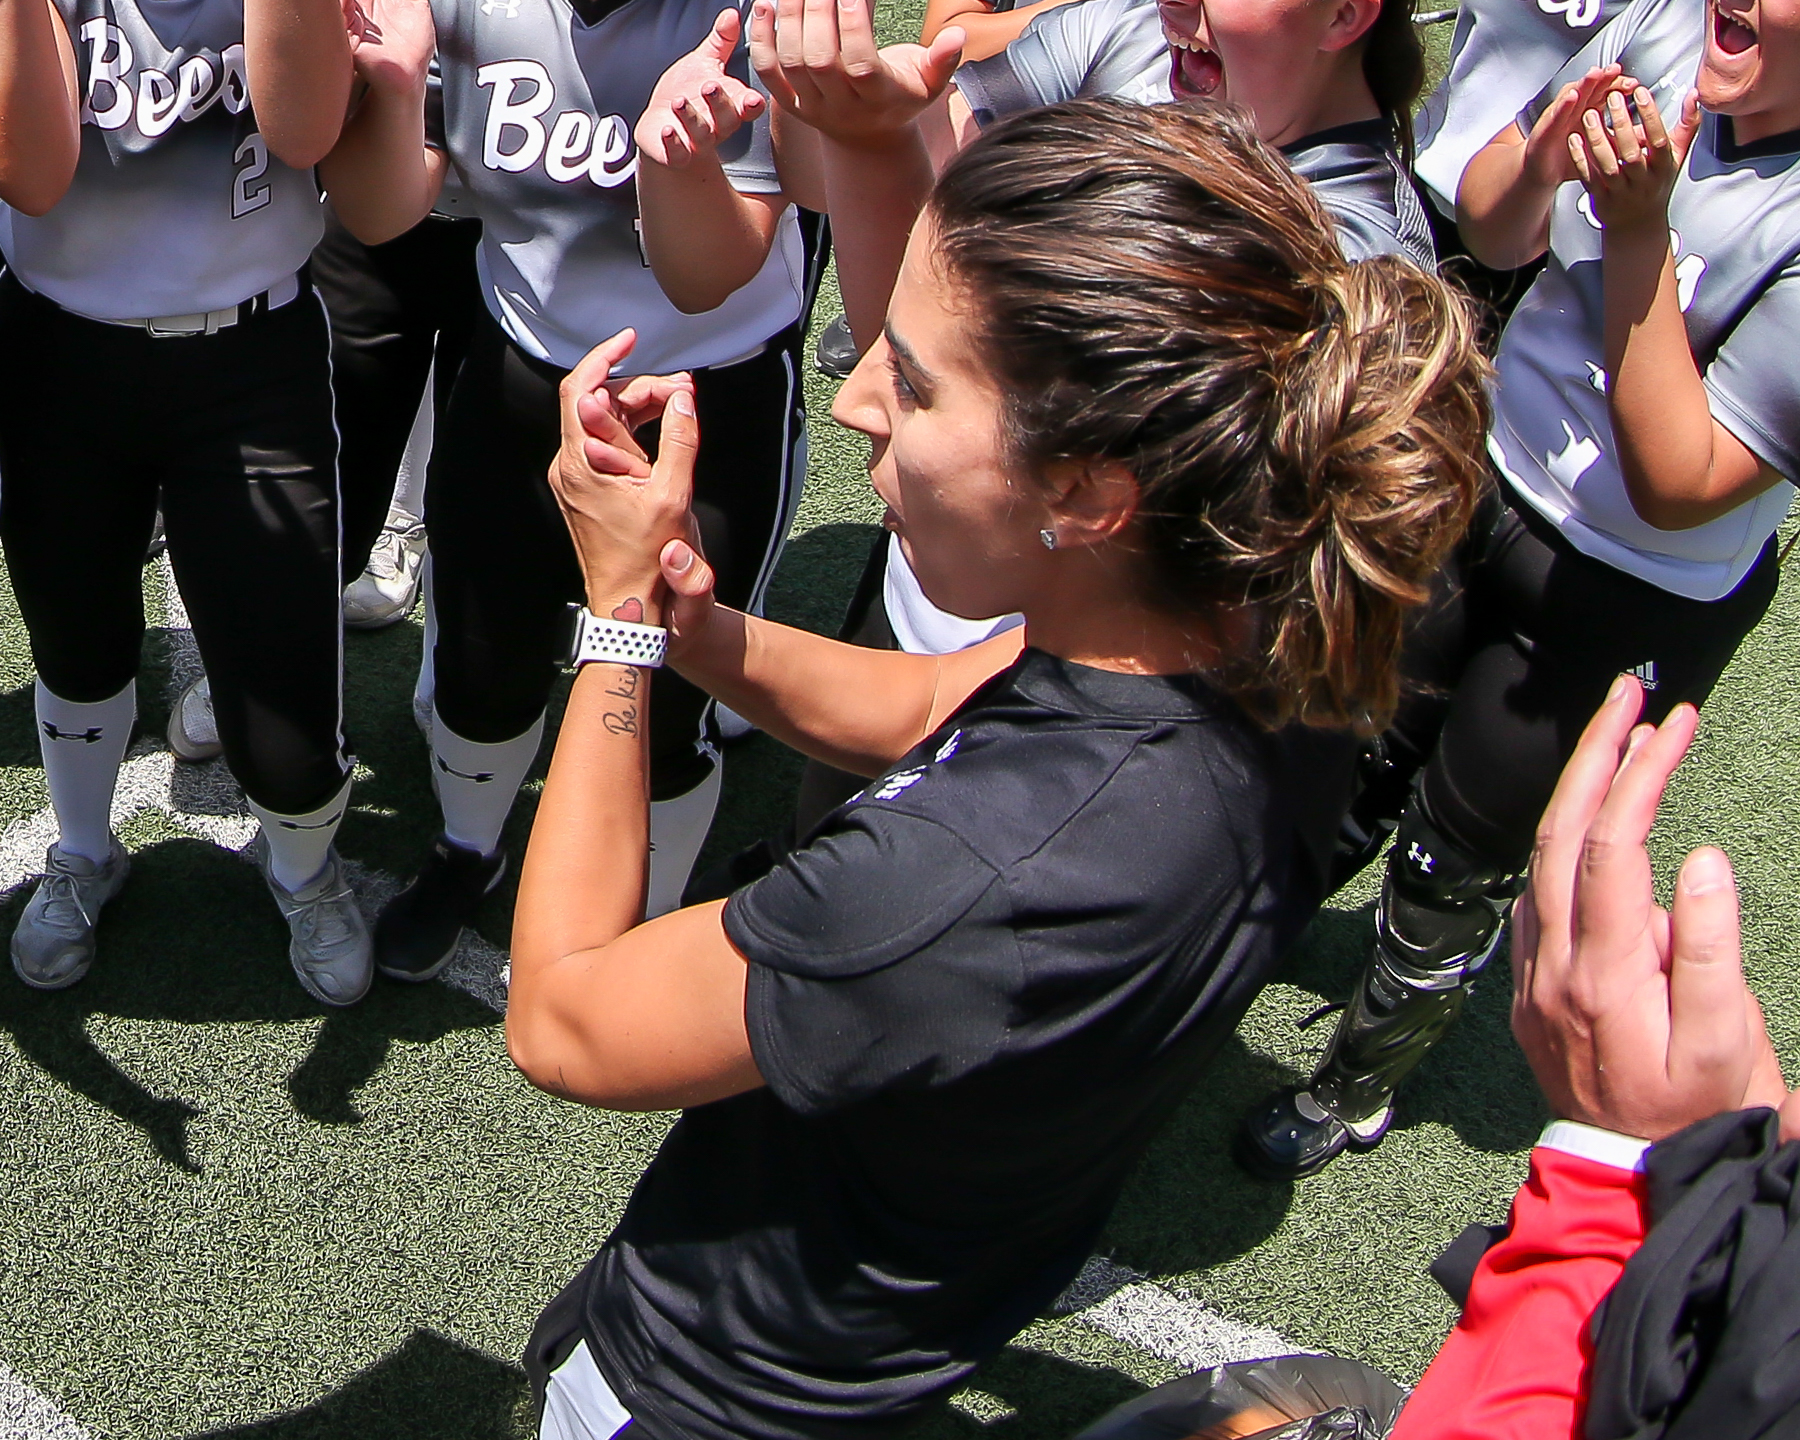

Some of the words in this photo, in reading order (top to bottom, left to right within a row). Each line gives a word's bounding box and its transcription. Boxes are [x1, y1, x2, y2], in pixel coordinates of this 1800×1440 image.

[80, 16, 251, 139] Bees
[476, 58, 638, 189] Bee
[602, 704, 638, 739] Be
